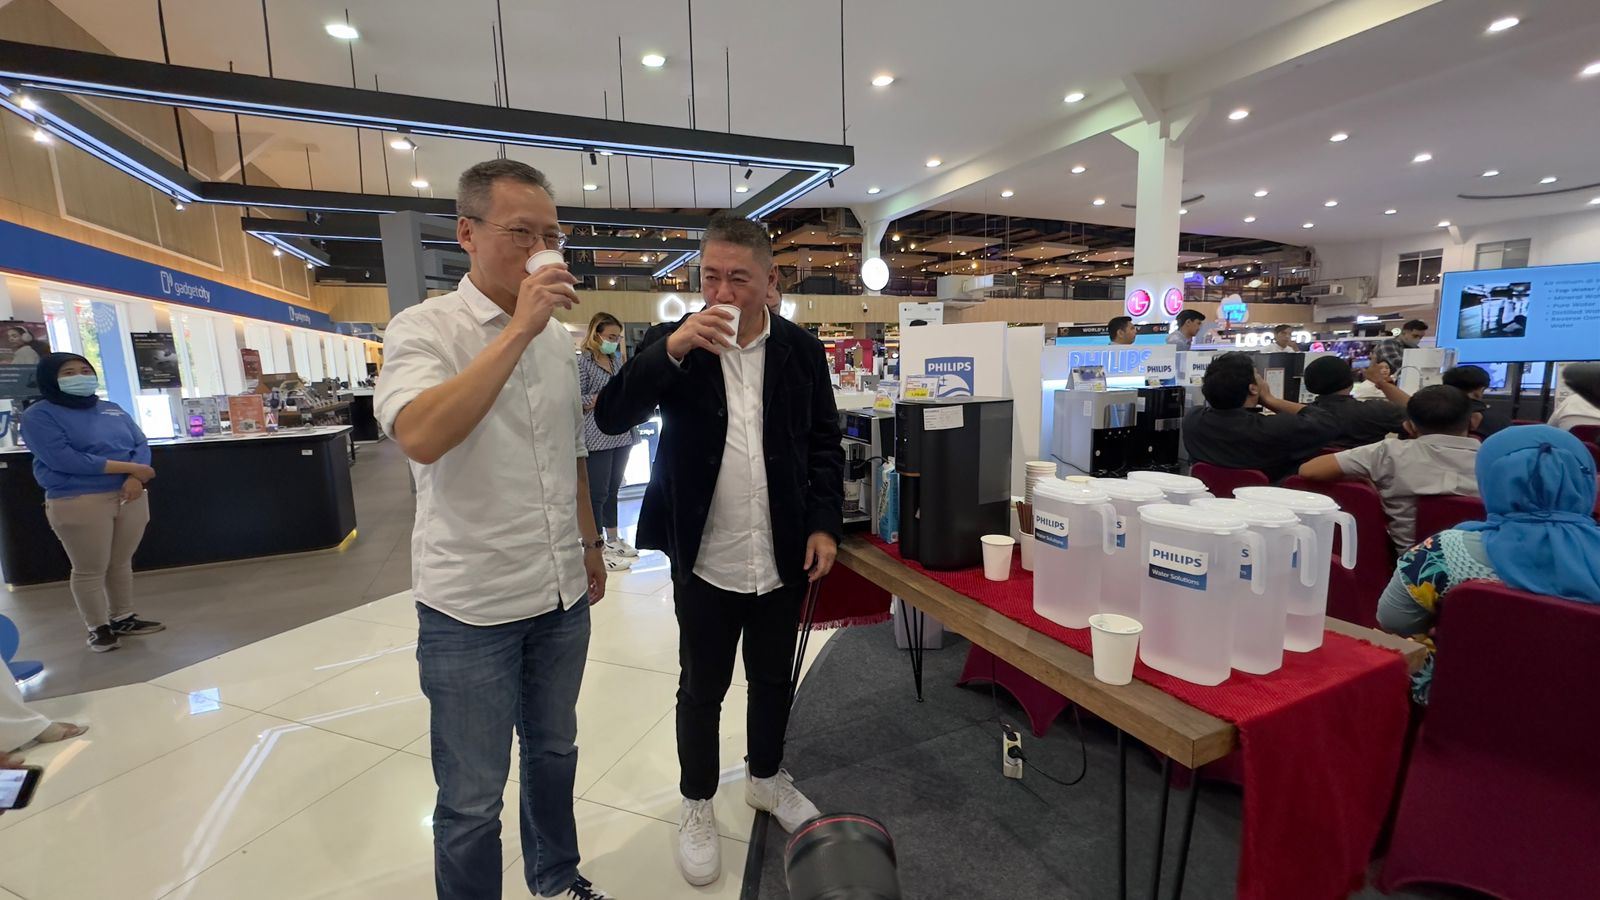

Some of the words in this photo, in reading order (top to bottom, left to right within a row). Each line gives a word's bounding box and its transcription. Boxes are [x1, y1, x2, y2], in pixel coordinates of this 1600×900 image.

[174, 281, 211, 303] gadgetcity
[927, 362, 972, 372] PHILIPS
[1068, 349, 1153, 375] PHILIPS
[1146, 365, 1172, 373] PHILIPS
[1036, 515, 1065, 531] PHILIPS
[1152, 548, 1202, 568] PHILIPS
[1151, 567, 1169, 578] Water
[1170, 573, 1200, 586] Solutions
